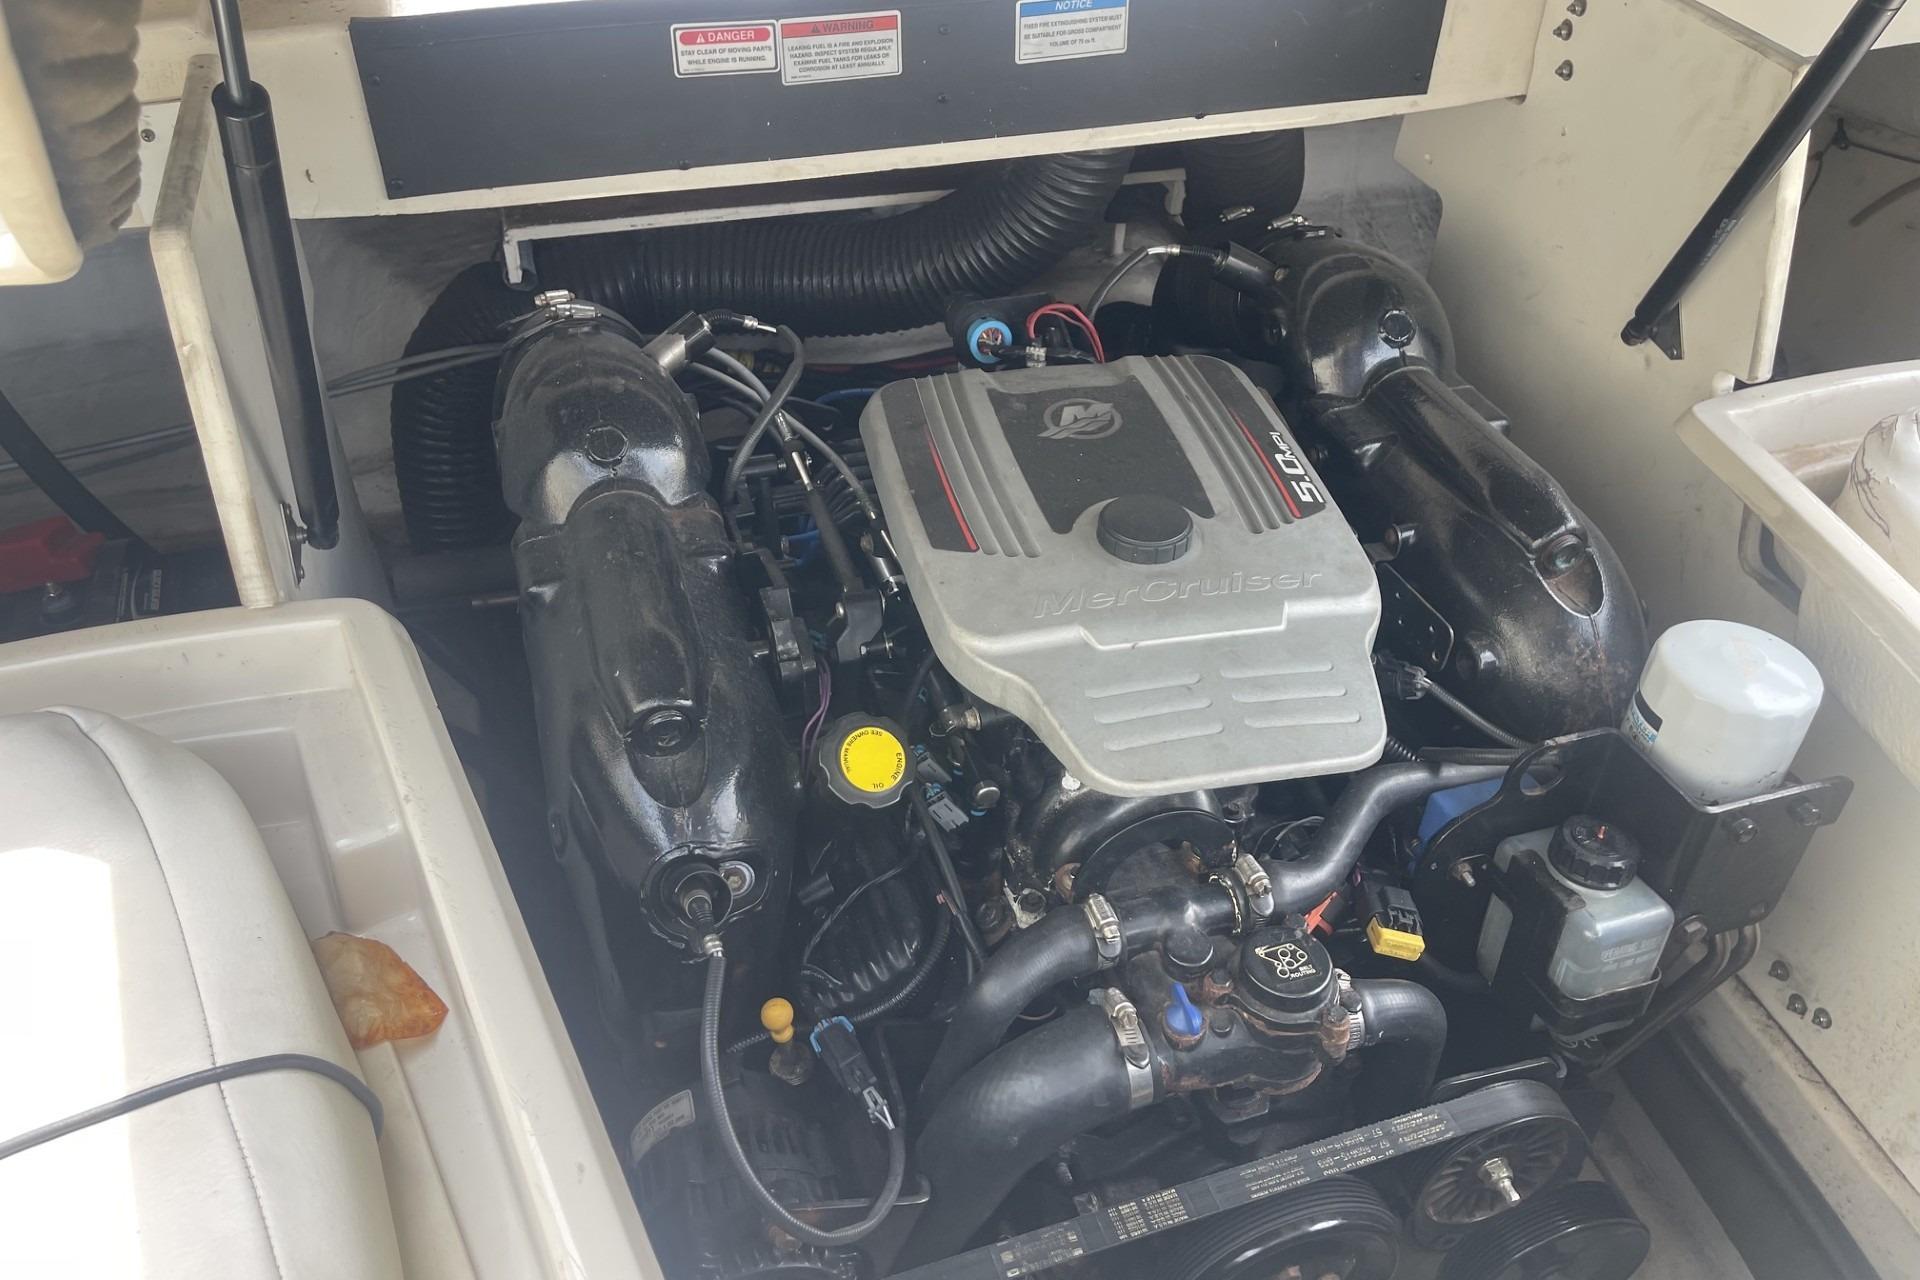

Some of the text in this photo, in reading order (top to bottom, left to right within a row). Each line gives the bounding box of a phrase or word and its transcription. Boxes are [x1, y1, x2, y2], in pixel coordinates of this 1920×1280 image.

[1056, 0, 1093, 10] NOTICE
[823, 20, 874, 33] WARNING
[707, 30, 755, 42] DANGER
[696, 48, 718, 56] CLEAR
[727, 46, 752, 54] MOVING
[1269, 431, 1325, 503] 5.0 MPI
[1033, 571, 1323, 619] MerCruiser
[870, 729, 883, 737] SEE
[890, 752, 903, 781] ENGINE
[1290, 969, 1316, 980] ROUTING
